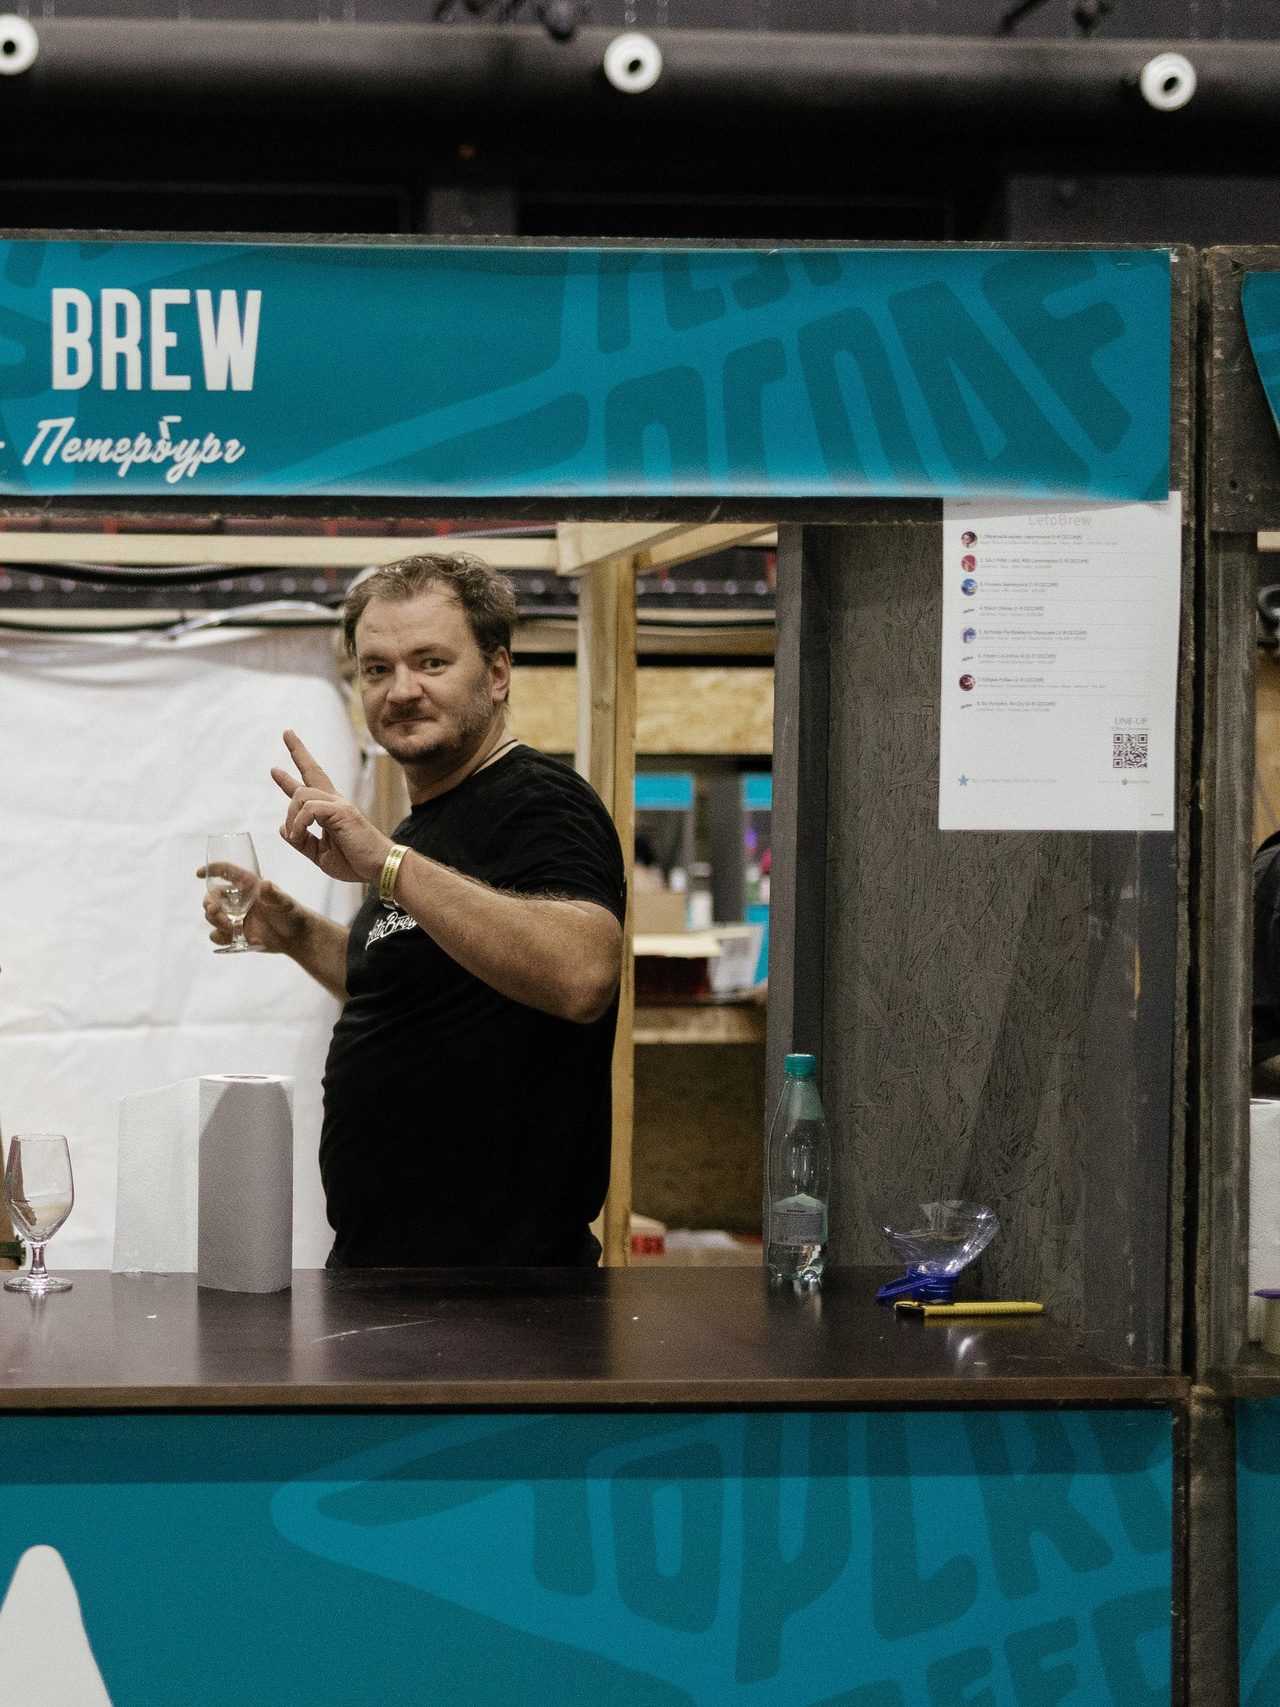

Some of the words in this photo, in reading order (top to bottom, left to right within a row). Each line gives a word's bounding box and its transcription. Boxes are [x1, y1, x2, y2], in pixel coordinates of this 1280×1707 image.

[51, 287, 263, 391] BREW
[22, 415, 246, 483] Петербург
[1028, 514, 1092, 526] LetoBrew
